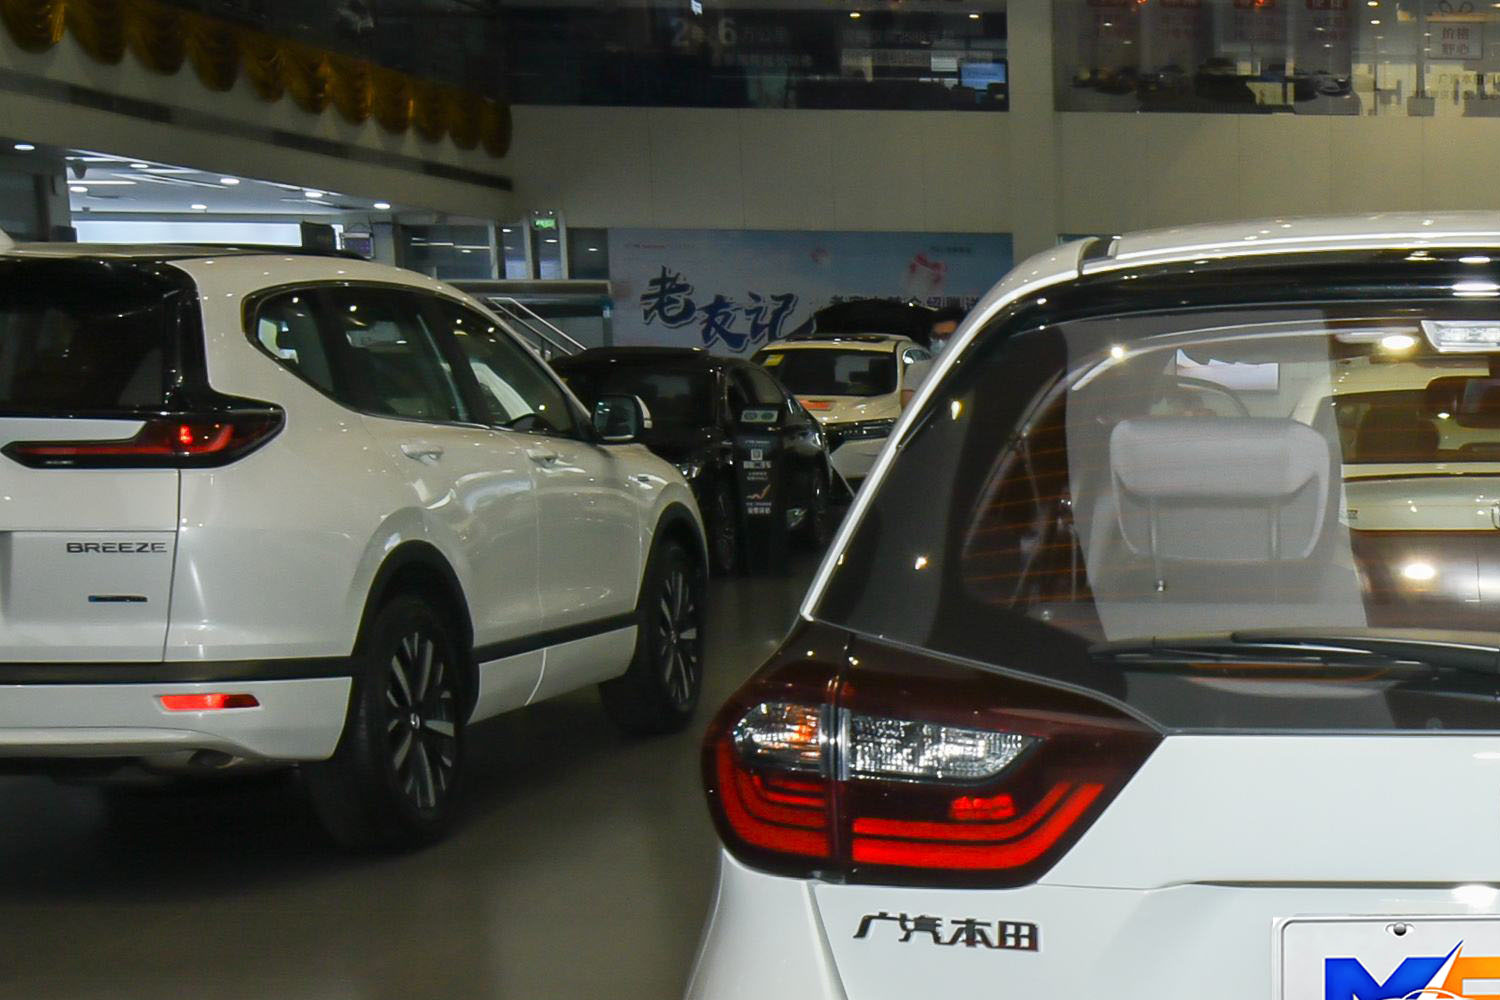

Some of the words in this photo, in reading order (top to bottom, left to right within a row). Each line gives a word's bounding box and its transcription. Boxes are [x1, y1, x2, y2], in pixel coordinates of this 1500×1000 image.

[640, 265, 804, 352] 老友记
[66, 542, 168, 554] BREEZE
[852, 911, 1040, 953] 广汽本田
